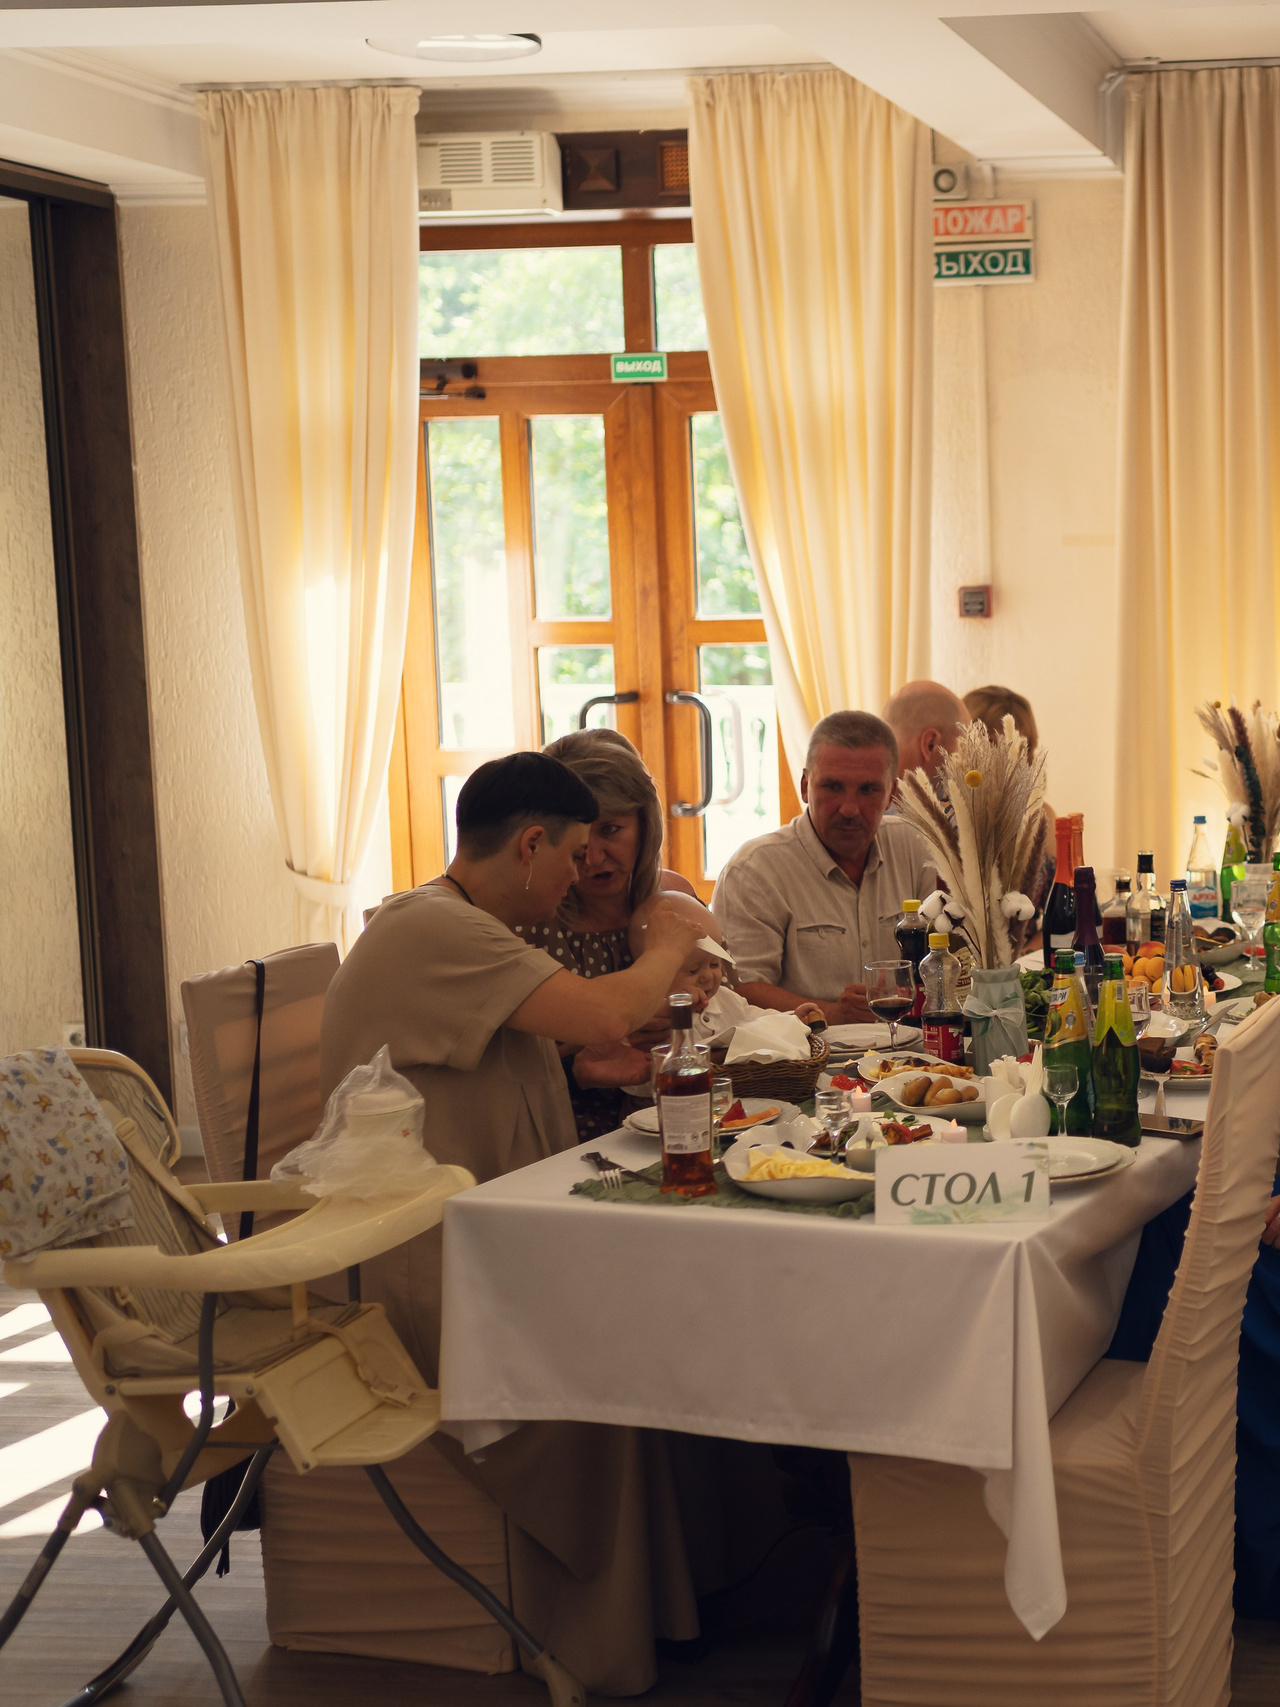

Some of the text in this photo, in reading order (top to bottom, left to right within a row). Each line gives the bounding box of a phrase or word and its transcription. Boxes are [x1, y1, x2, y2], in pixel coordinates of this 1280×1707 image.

[616, 360, 661, 373] ВЫХОД
[890, 1170, 1036, 1206] СТОЛ 1
